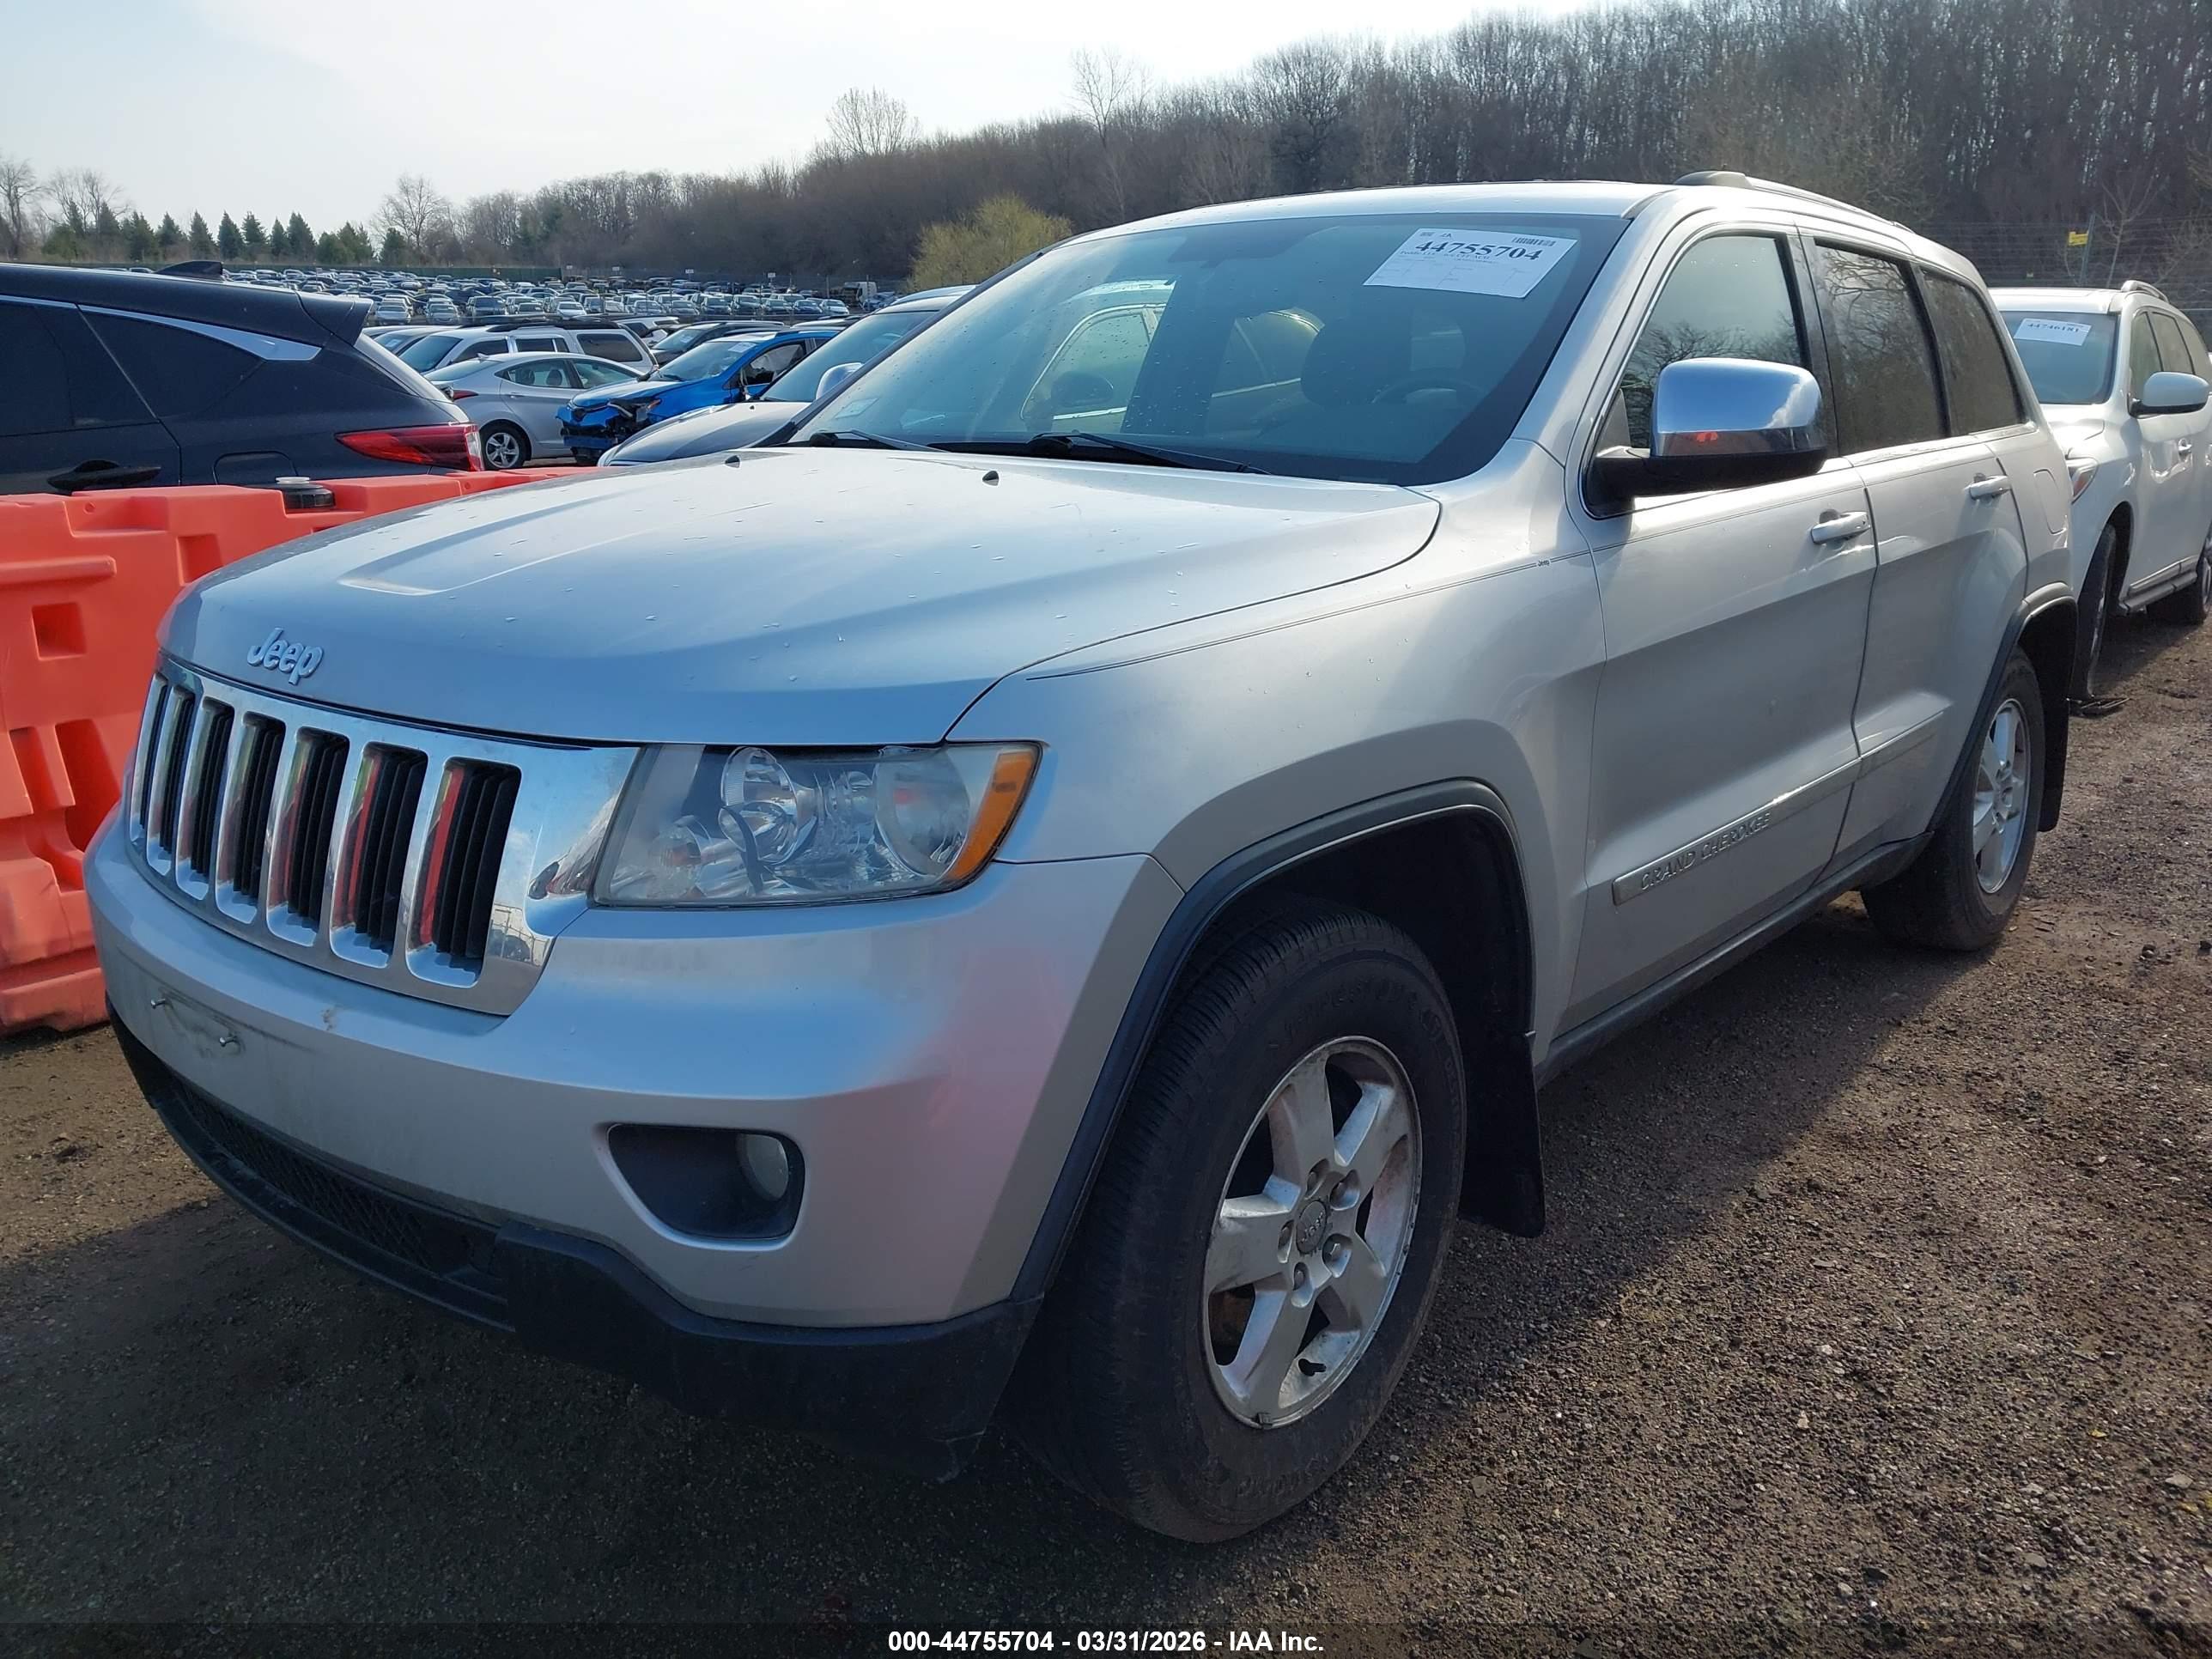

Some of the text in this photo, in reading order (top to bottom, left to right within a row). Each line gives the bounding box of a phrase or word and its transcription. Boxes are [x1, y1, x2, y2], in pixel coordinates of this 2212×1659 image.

[1415, 240, 1543, 261] 44755704
[2026, 323, 2079, 333] 44746181
[246, 626, 325, 686] Jeep
[1640, 811, 1771, 890] GRAND CHEROKEE
